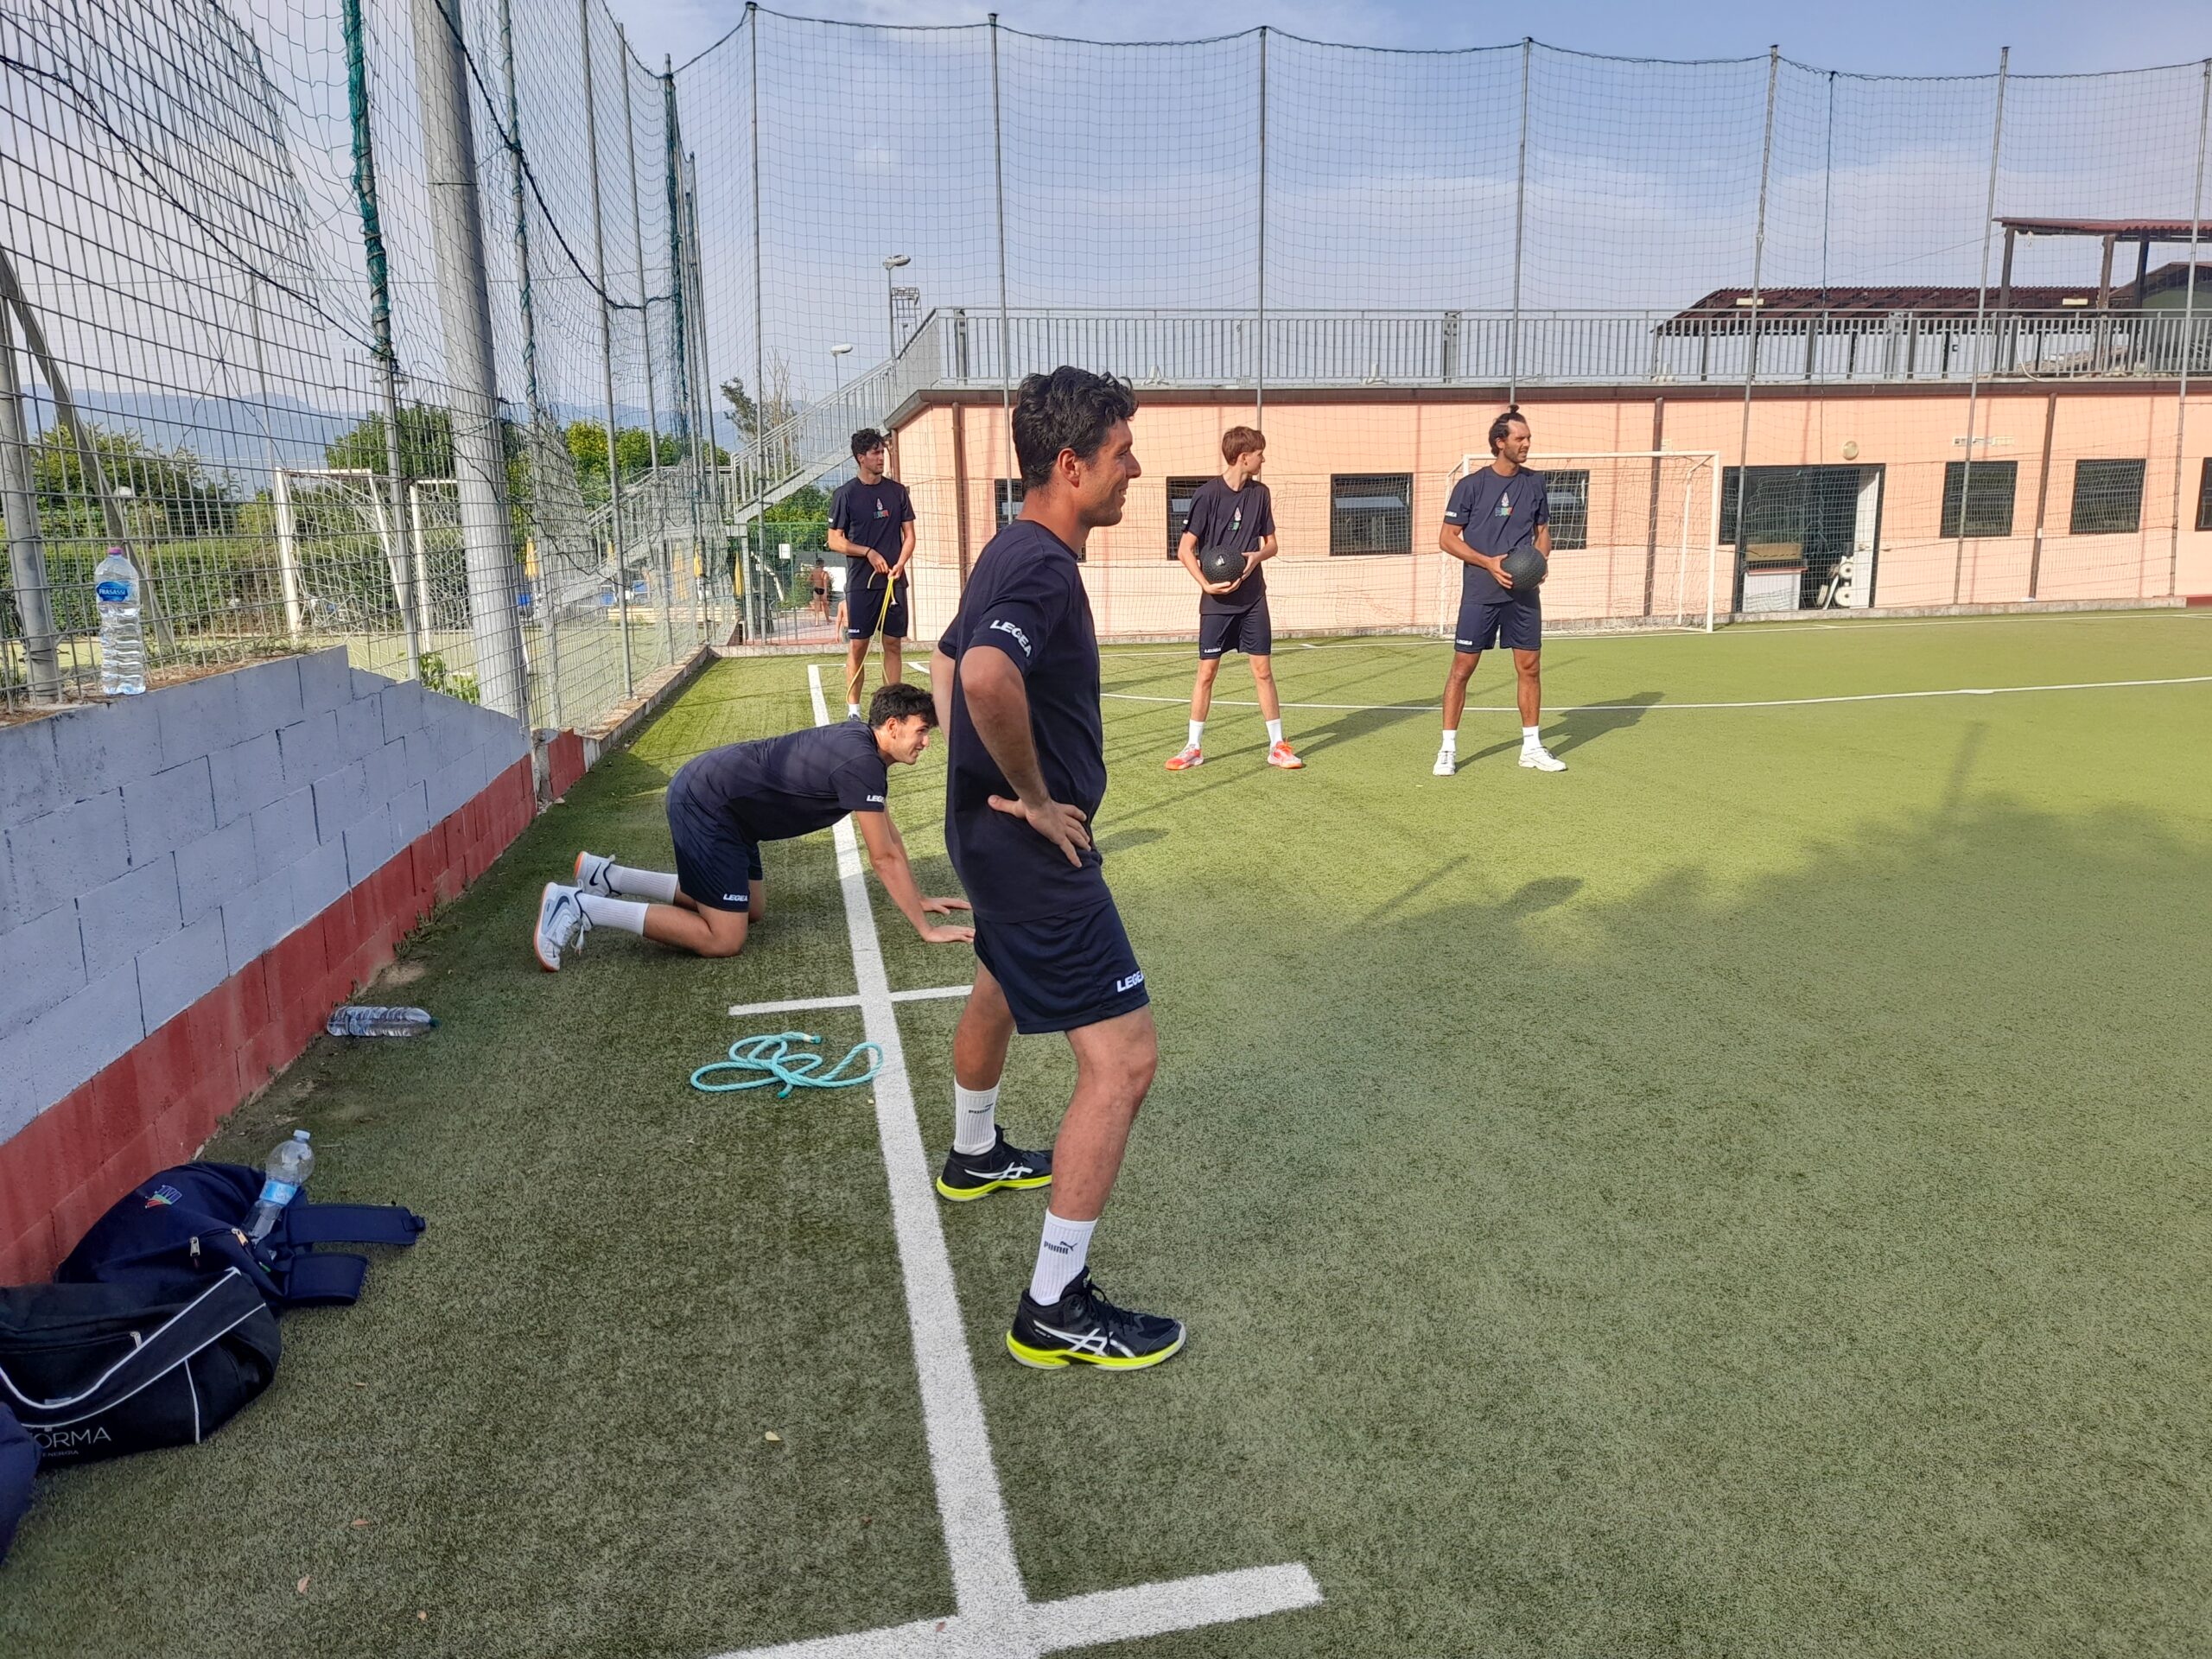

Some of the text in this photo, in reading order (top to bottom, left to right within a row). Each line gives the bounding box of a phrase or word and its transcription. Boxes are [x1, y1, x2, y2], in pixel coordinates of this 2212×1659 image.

[988, 620, 1033, 657] LEGEA
[1116, 969, 1145, 993] LEGE
[30, 1426, 112, 1449] ORMA
